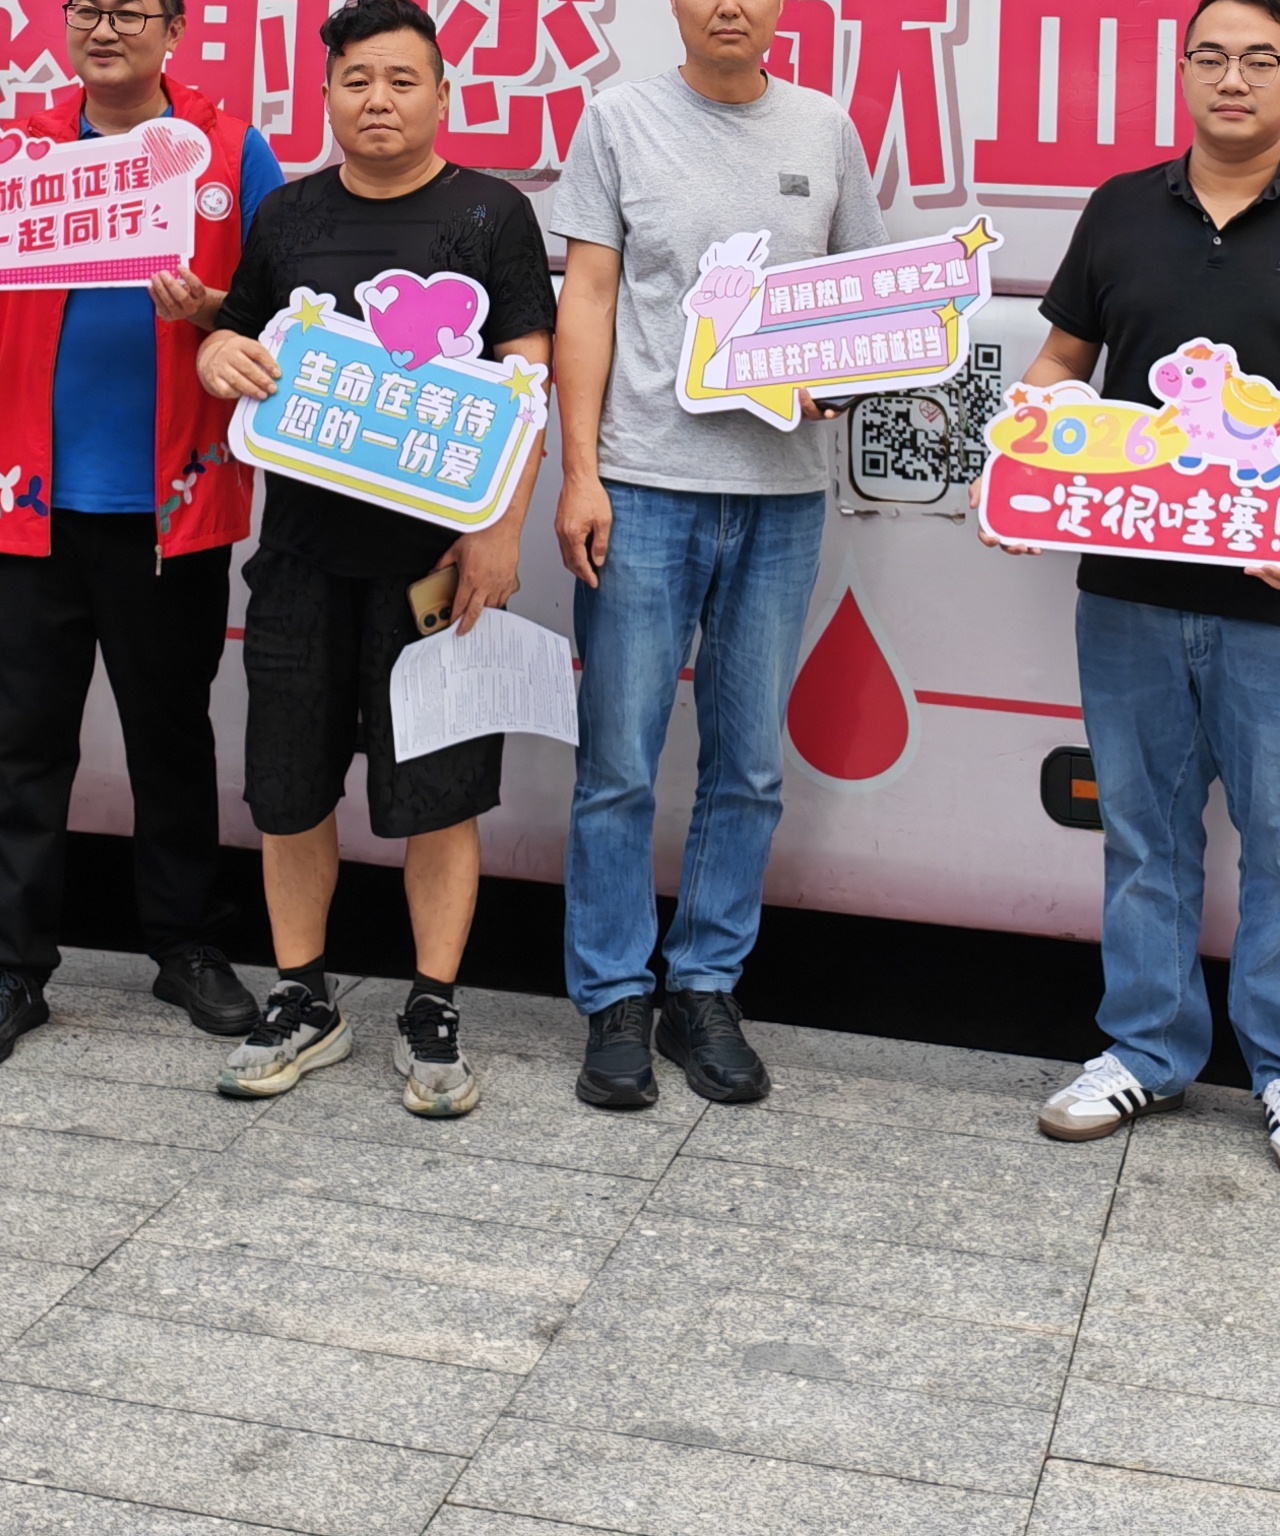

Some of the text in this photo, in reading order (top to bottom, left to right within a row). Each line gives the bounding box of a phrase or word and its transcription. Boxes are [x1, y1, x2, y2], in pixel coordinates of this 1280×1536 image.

[769, 258, 970, 316] 涓涓热血 拳拳之心
[734, 325, 943, 383] 映照着共产党人的赤诚担当
[294, 349, 497, 440] 生命在等待
[277, 393, 483, 489] 您的一份爱
[1010, 405, 1157, 466] 2026
